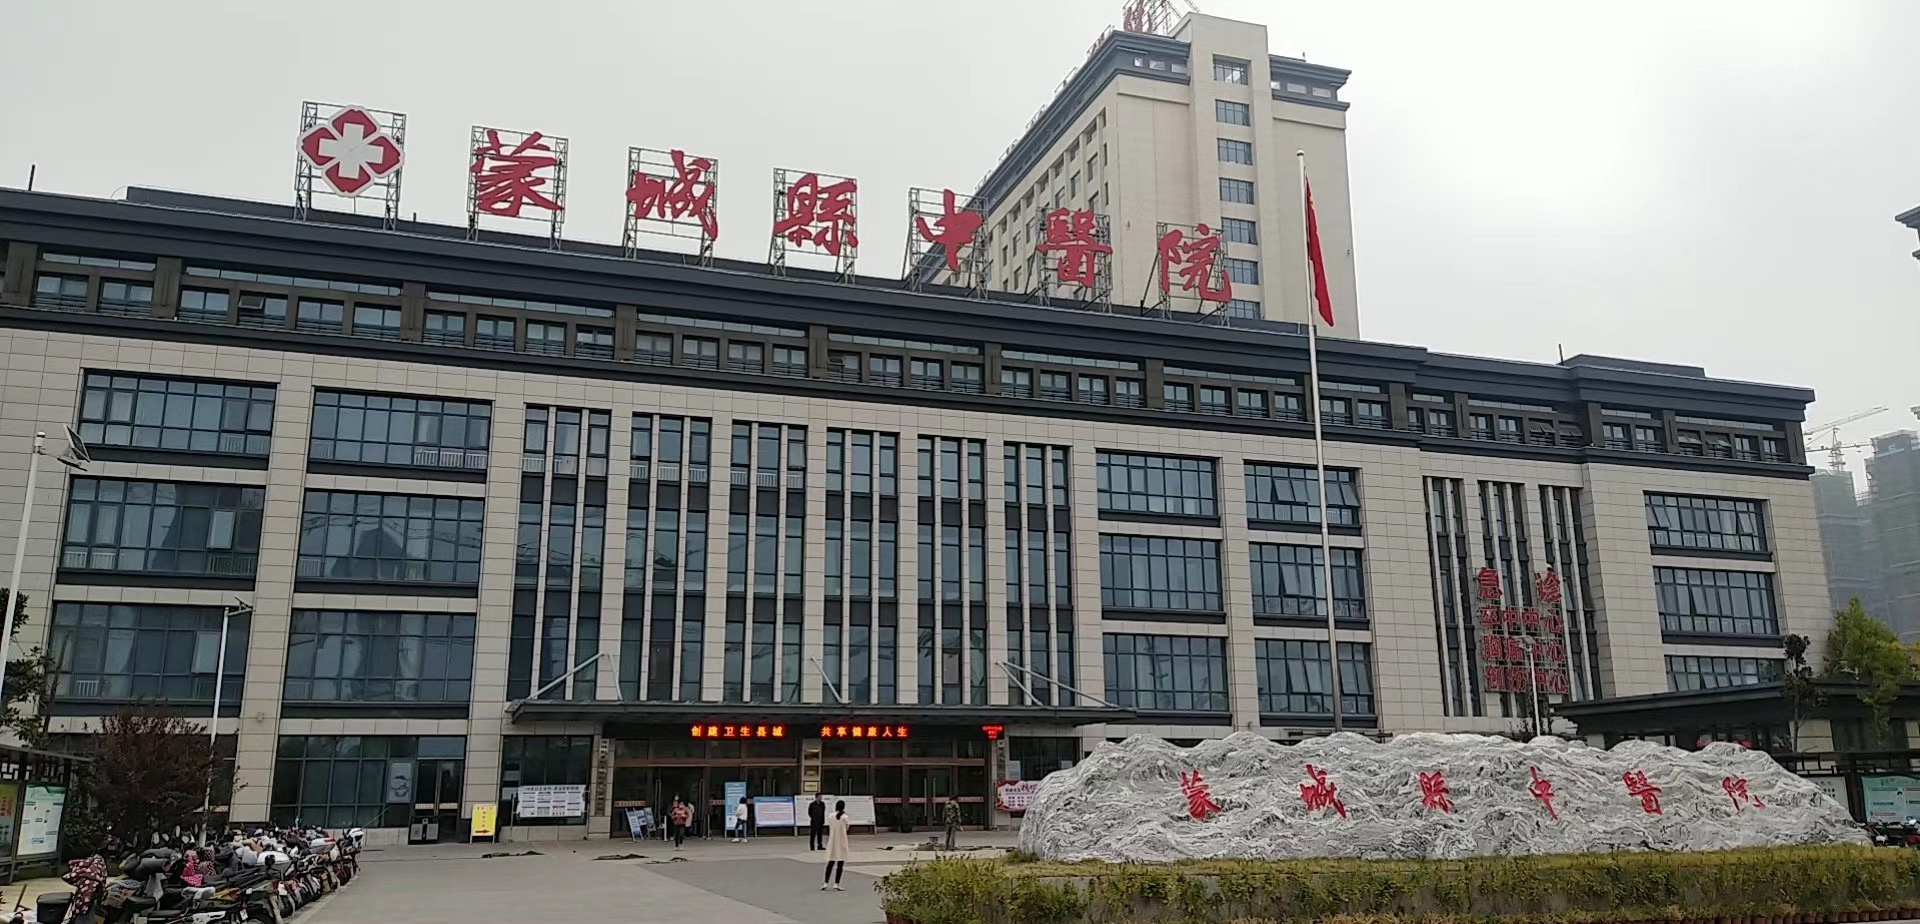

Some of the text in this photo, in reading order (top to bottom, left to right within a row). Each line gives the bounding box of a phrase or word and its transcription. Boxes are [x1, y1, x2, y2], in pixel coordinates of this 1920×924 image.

[1478, 567, 1562, 603] 急诊
[1480, 604, 1563, 633] 卒中中心
[691, 725, 909, 738] 创建卫生县城 共享健康人生
